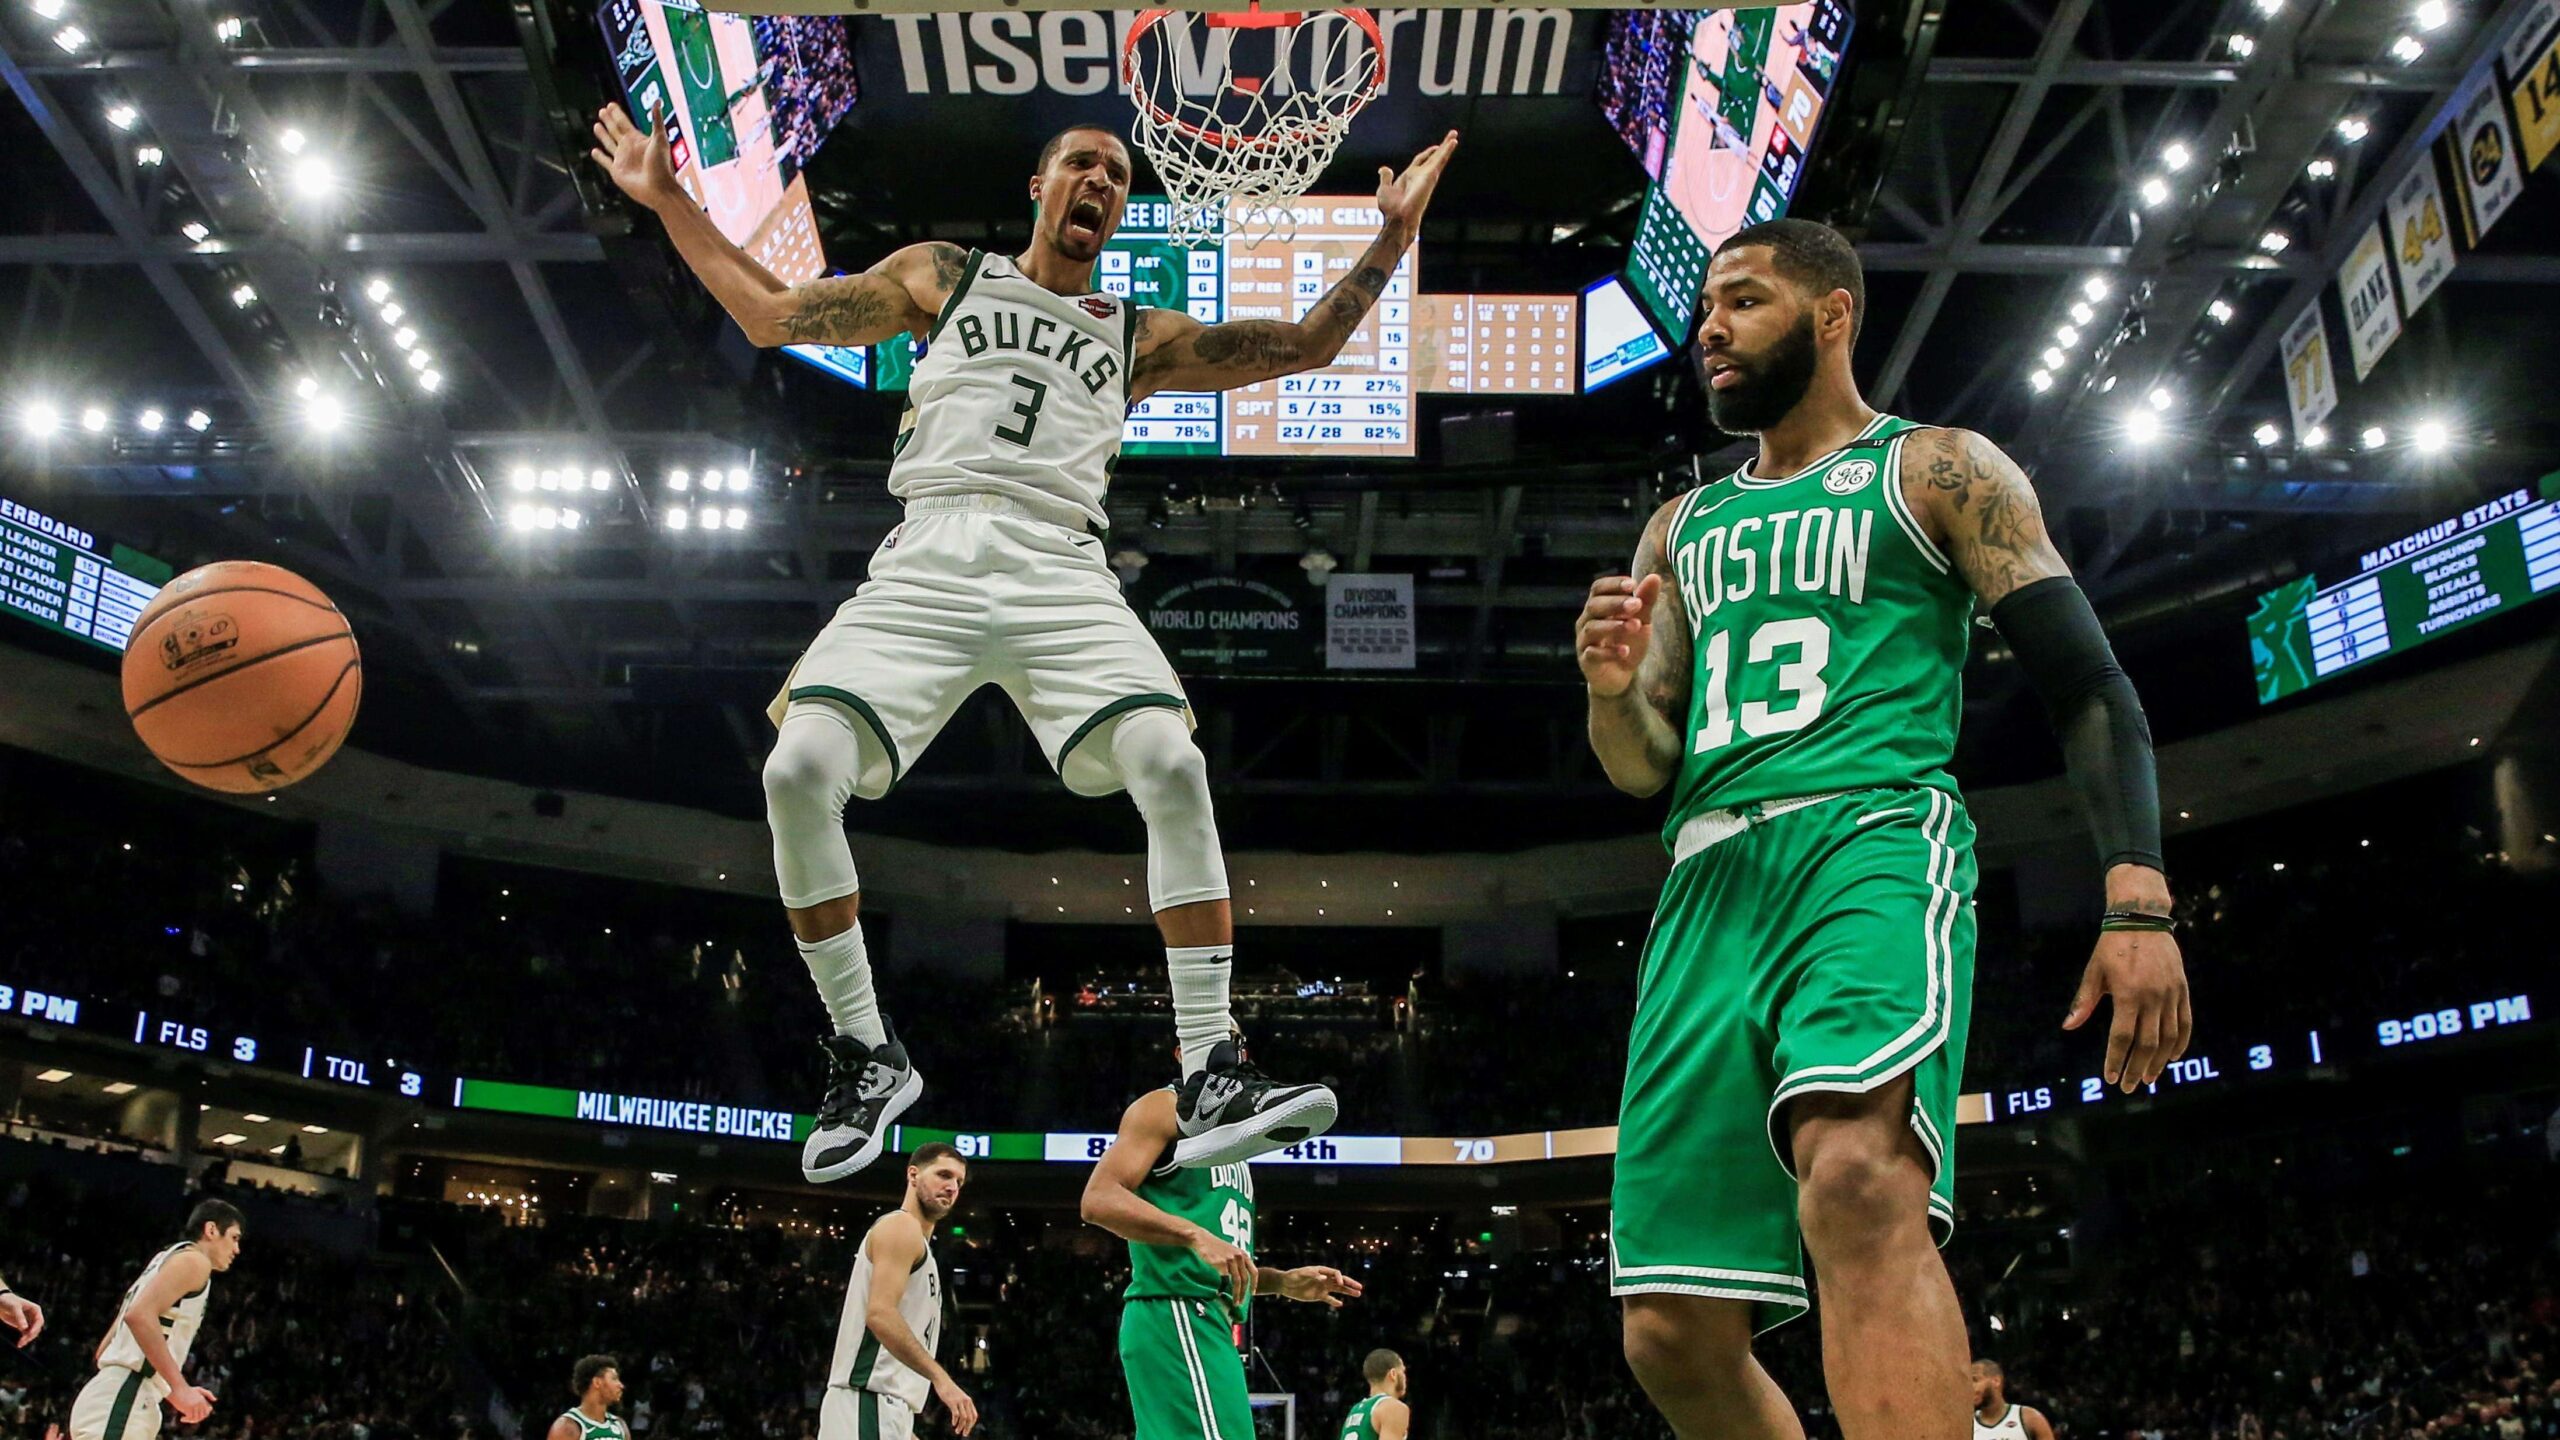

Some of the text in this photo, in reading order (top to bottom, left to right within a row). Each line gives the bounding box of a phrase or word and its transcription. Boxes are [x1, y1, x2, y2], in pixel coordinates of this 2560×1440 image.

[1135, 257, 1161, 268] AST
[1107, 282, 1124, 292] 40
[1300, 283, 1317, 293] 32
[1387, 333, 1401, 342] 15
[956, 313, 1118, 395] BUCKS
[1389, 356, 1398, 365] 4
[1285, 381, 1301, 391] 21
[1322, 381, 1341, 391] 77
[1365, 379, 1401, 392] 27%
[995, 374, 1047, 449] 3
[1174, 402, 1210, 414] 28%
[1236, 401, 1274, 416] 3PT
[1288, 404, 1298, 414] 5
[1321, 404, 1341, 414] 33
[1369, 402, 1401, 416] 15%
[1132, 425, 1210, 438] 18 78%
[1235, 424, 1260, 439] FT
[1283, 427, 1303, 438] 23
[1321, 427, 1342, 438] 28
[1364, 425, 1401, 439] 82%
[0, 498, 94, 550] ERBOARD
[2360, 489, 2530, 571] MATCHUP STATS
[5, 543, 56, 574] LEADER
[6, 528, 57, 559] LEADER
[2411, 535, 2487, 574] REBOUNDS
[16, 564, 67, 595] LEADER
[1676, 507, 1875, 640] BOSTON
[2423, 554, 2479, 585] BLOCKS
[2428, 570, 2481, 600] STEALS
[7, 593, 59, 622] LEADER
[12, 578, 63, 608] LEADER
[1344, 588, 1397, 602] DIVISION
[1150, 610, 1299, 630] WORLD CHAMPIONS
[1334, 604, 1407, 619] CHAMPIONS
[2416, 593, 2502, 634] TURNOVERS
[1694, 616, 1830, 755] 13
[21, 989, 78, 1025] PM
[2377, 995, 2532, 1046] 9:08 PM
[159, 1021, 257, 1062] FLS 3
[325, 1055, 422, 1097] TOL 3
[2167, 1045, 2273, 1086] TOL 3
[2008, 1077, 2103, 1115] FLS 2
[576, 1090, 793, 1141] MILWAUKEE BUCKS
[953, 1134, 992, 1157] 91
[1283, 1140, 1337, 1160] 4th
[1452, 1139, 1496, 1161] 70
[1220, 1198, 1252, 1258] 42
